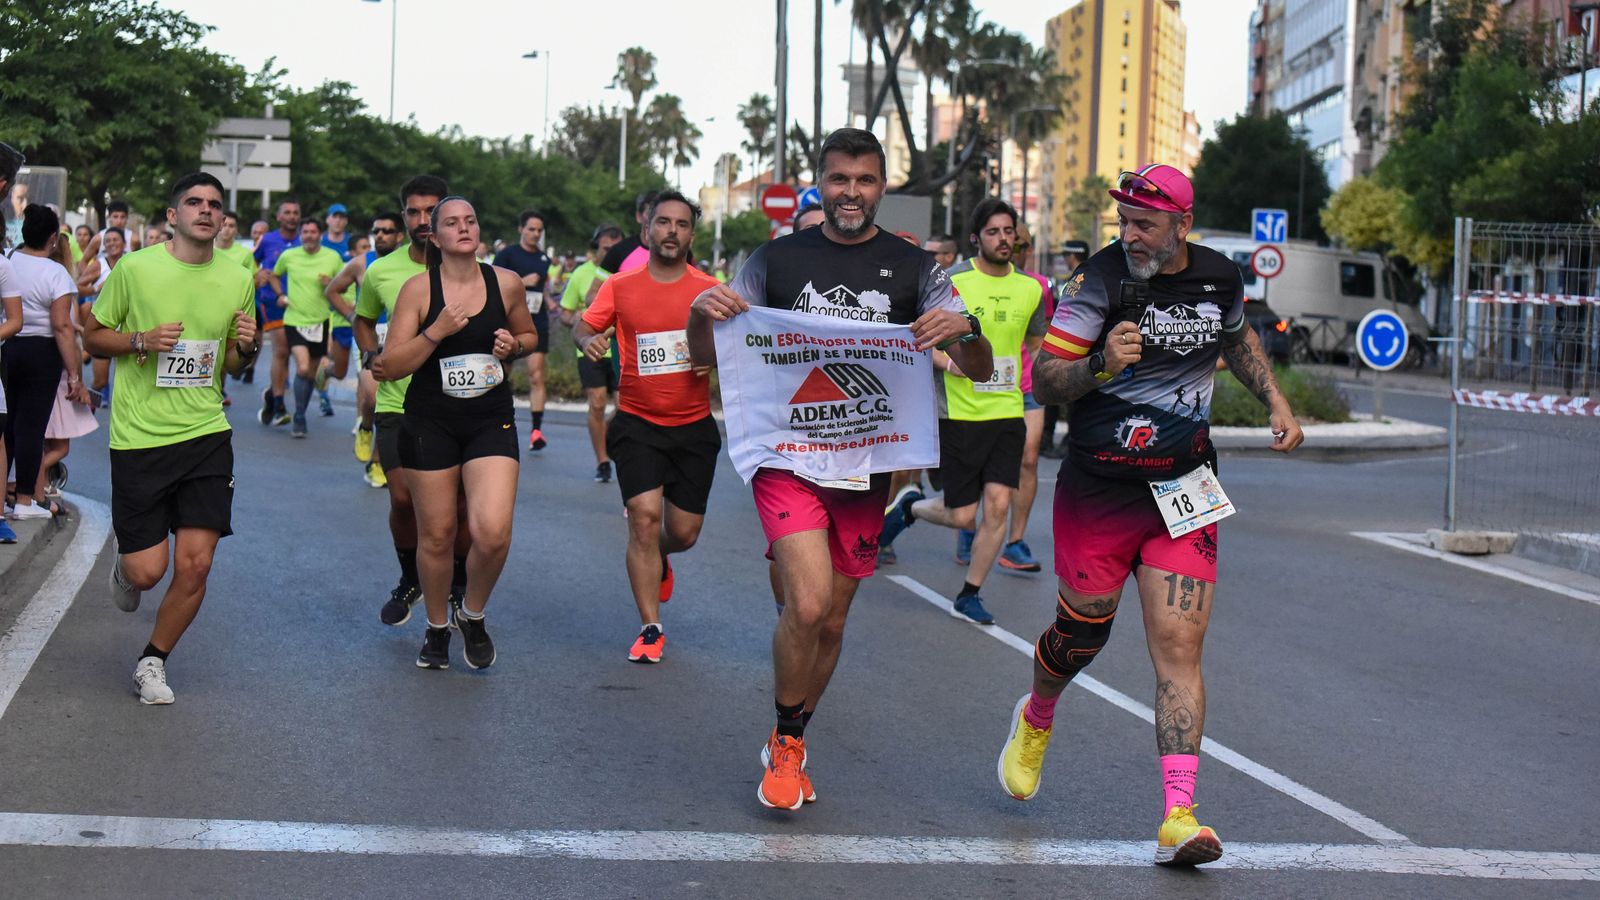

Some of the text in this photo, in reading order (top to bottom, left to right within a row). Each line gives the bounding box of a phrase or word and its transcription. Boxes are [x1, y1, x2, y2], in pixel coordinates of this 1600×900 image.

[1258, 256, 1277, 269] 30
[745, 333, 773, 347] CON
[777, 332, 857, 348] ESCLEROSIS
[1149, 333, 1217, 344] TRAIL
[640, 347, 666, 364] 689
[761, 346, 820, 365] TAMBIÉN
[824, 349, 841, 359] SE
[844, 349, 887, 361] PUEDE
[167, 356, 195, 374] 726
[448, 369, 476, 387] 632
[789, 398, 893, 424] ADEM-C.G.
[790, 422, 826, 431] Asociación
[837, 418, 868, 428] Esclerosis
[869, 414, 894, 422] Múltiple
[819, 430, 843, 440] Campo
[844, 428, 853, 436] de
[854, 424, 879, 435] Gibraltar
[1171, 493, 1195, 517] 18
